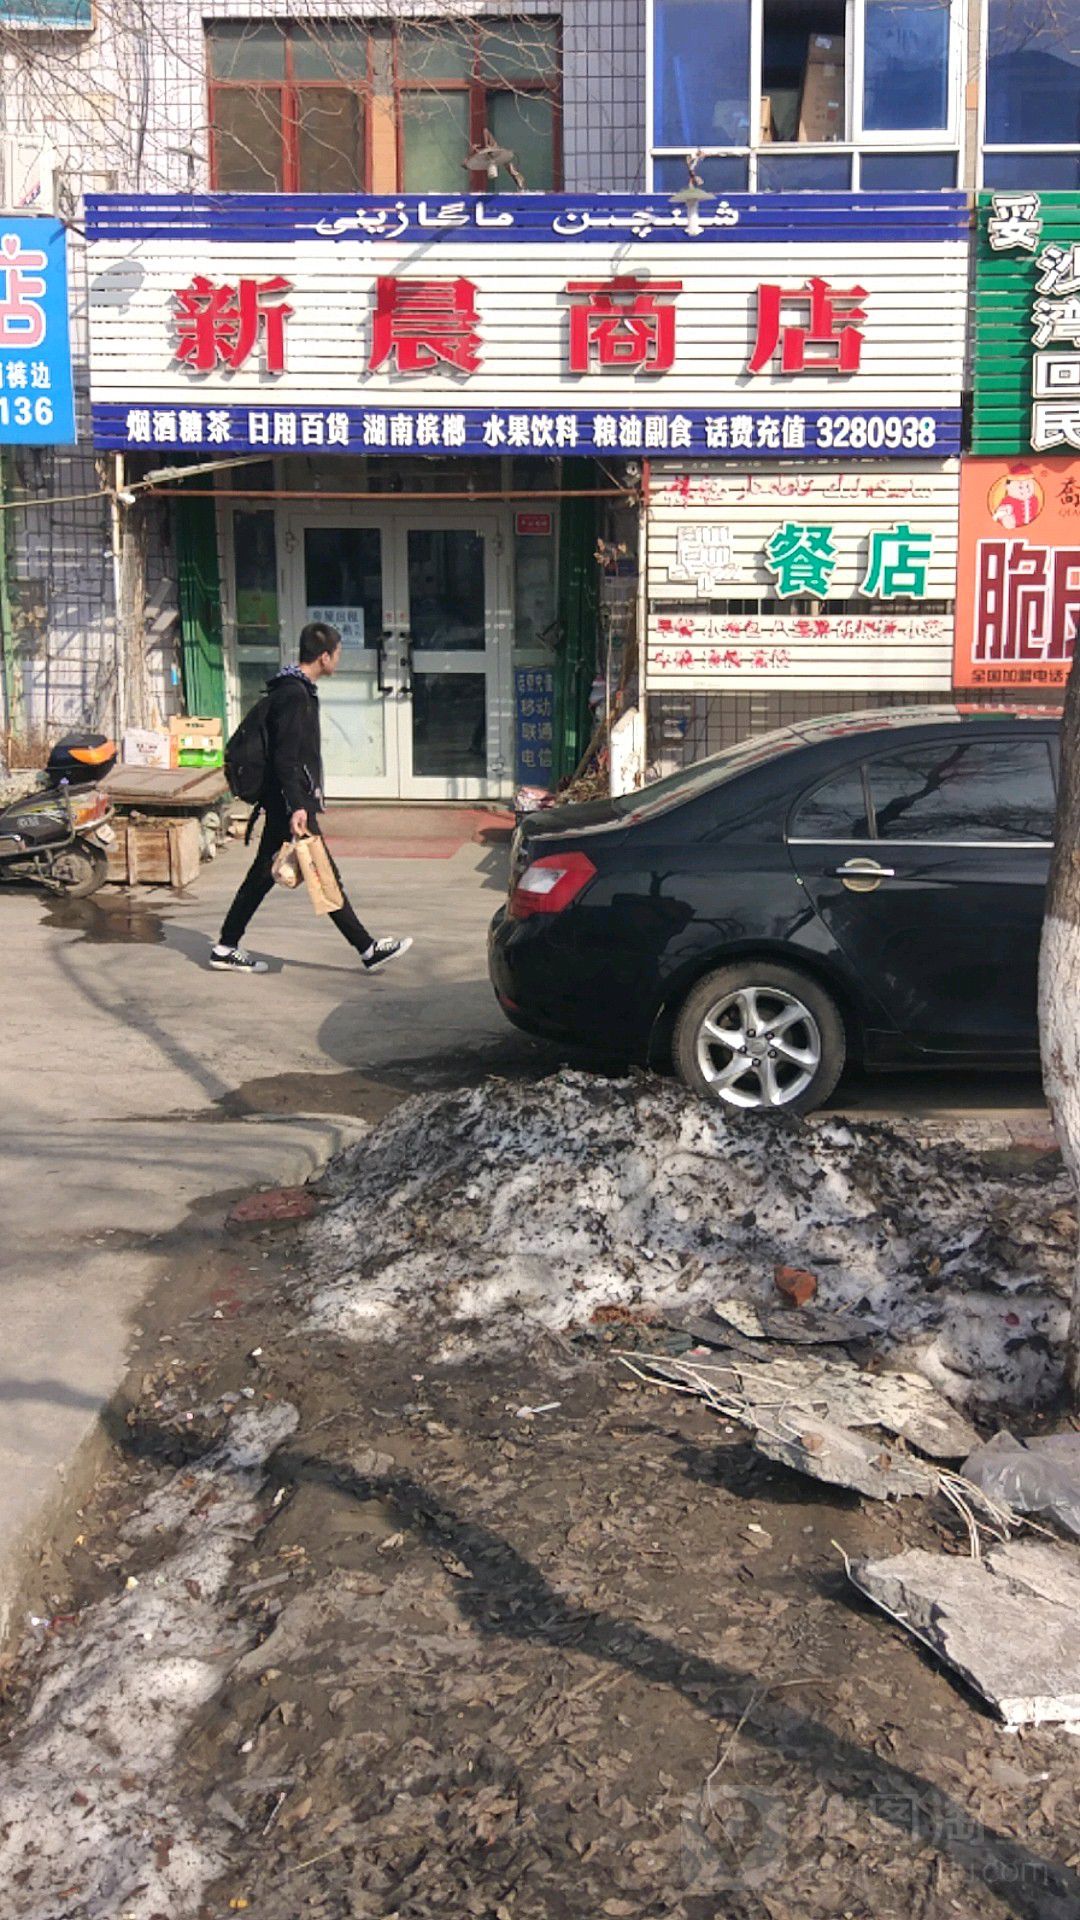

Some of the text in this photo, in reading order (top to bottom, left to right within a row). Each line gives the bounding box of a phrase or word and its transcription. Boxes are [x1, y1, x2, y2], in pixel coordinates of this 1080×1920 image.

[174, 275, 867, 375] 新晨商店
[0, 359, 52, 389] 裤边
[126, 409, 936, 449] 烟酒糖茶 日用百货 湖南槟榔 水果饮料 粮油副食 话费充值 3280938
[521, 698, 551, 717] 移动
[522, 722, 552, 740] 联通
[522, 749, 552, 768] 电信
